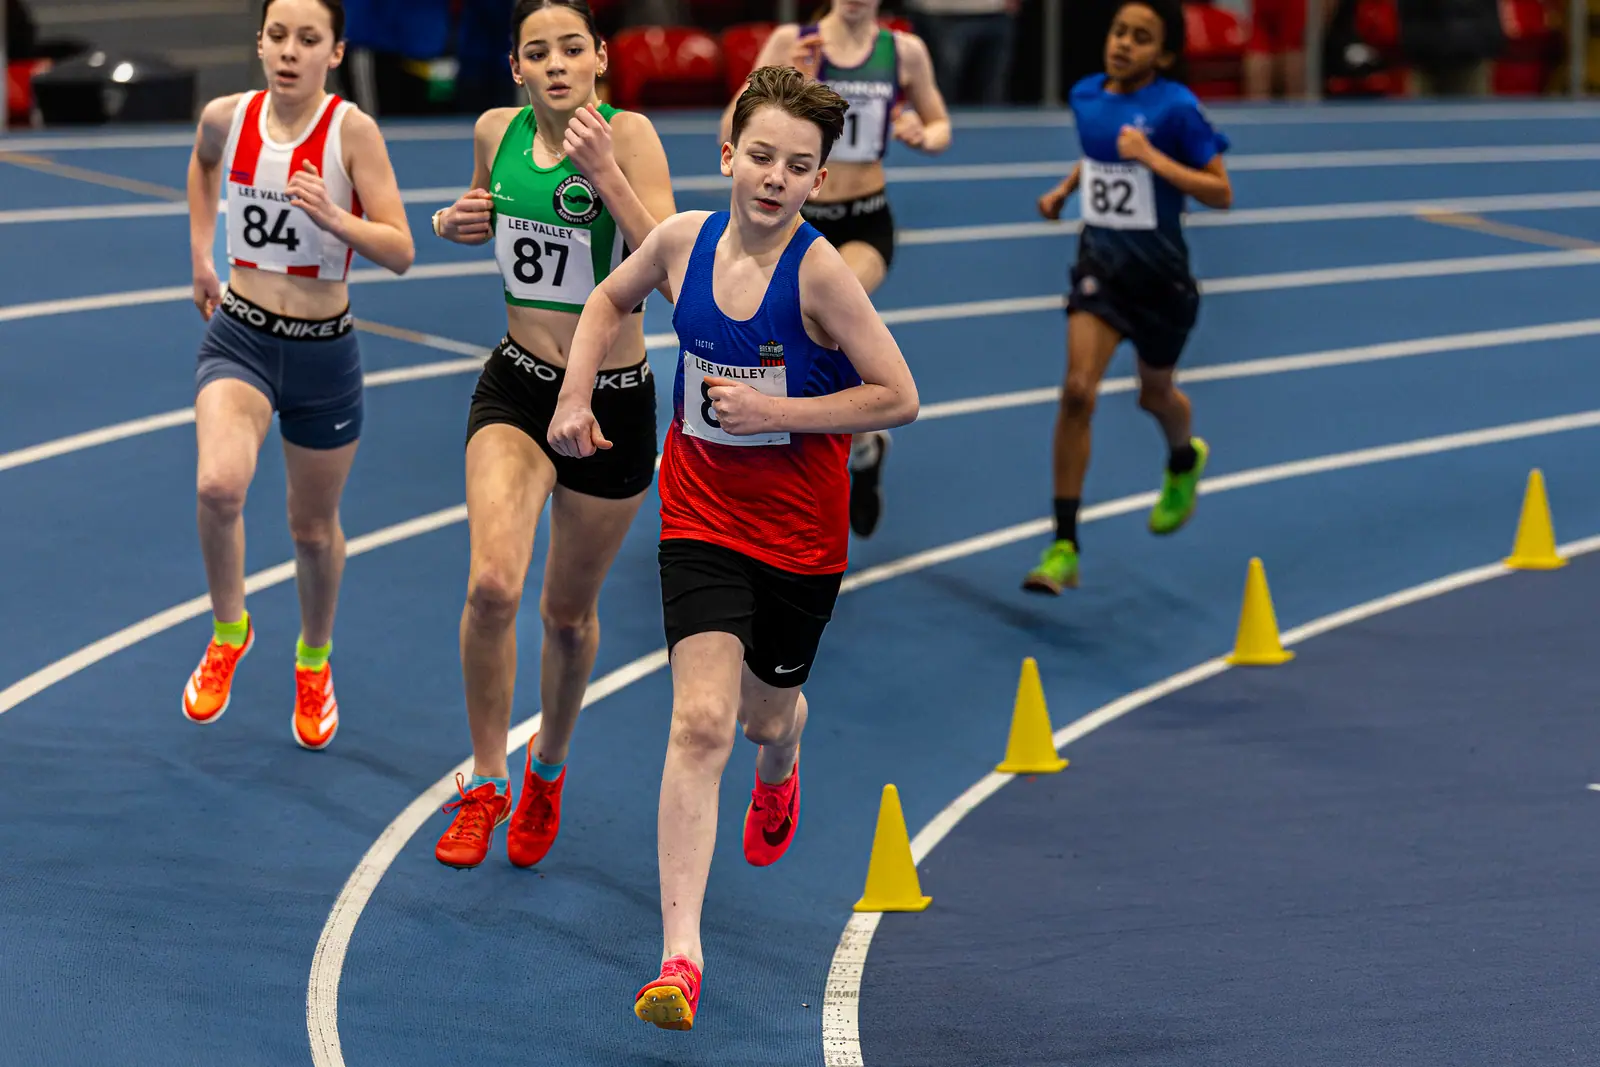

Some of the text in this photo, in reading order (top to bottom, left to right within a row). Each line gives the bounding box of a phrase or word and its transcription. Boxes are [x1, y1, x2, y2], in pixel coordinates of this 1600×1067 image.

[239, 186, 256, 199] LEE
[1091, 177, 1135, 216] 82
[243, 205, 300, 252] 84
[508, 218, 574, 240] LEE VALLEY
[513, 237, 569, 287] 87
[222, 290, 267, 327] PRO
[272, 319, 337, 338] NIKE
[502, 343, 558, 382] PRO
[695, 357, 767, 379] LEE VALLEY
